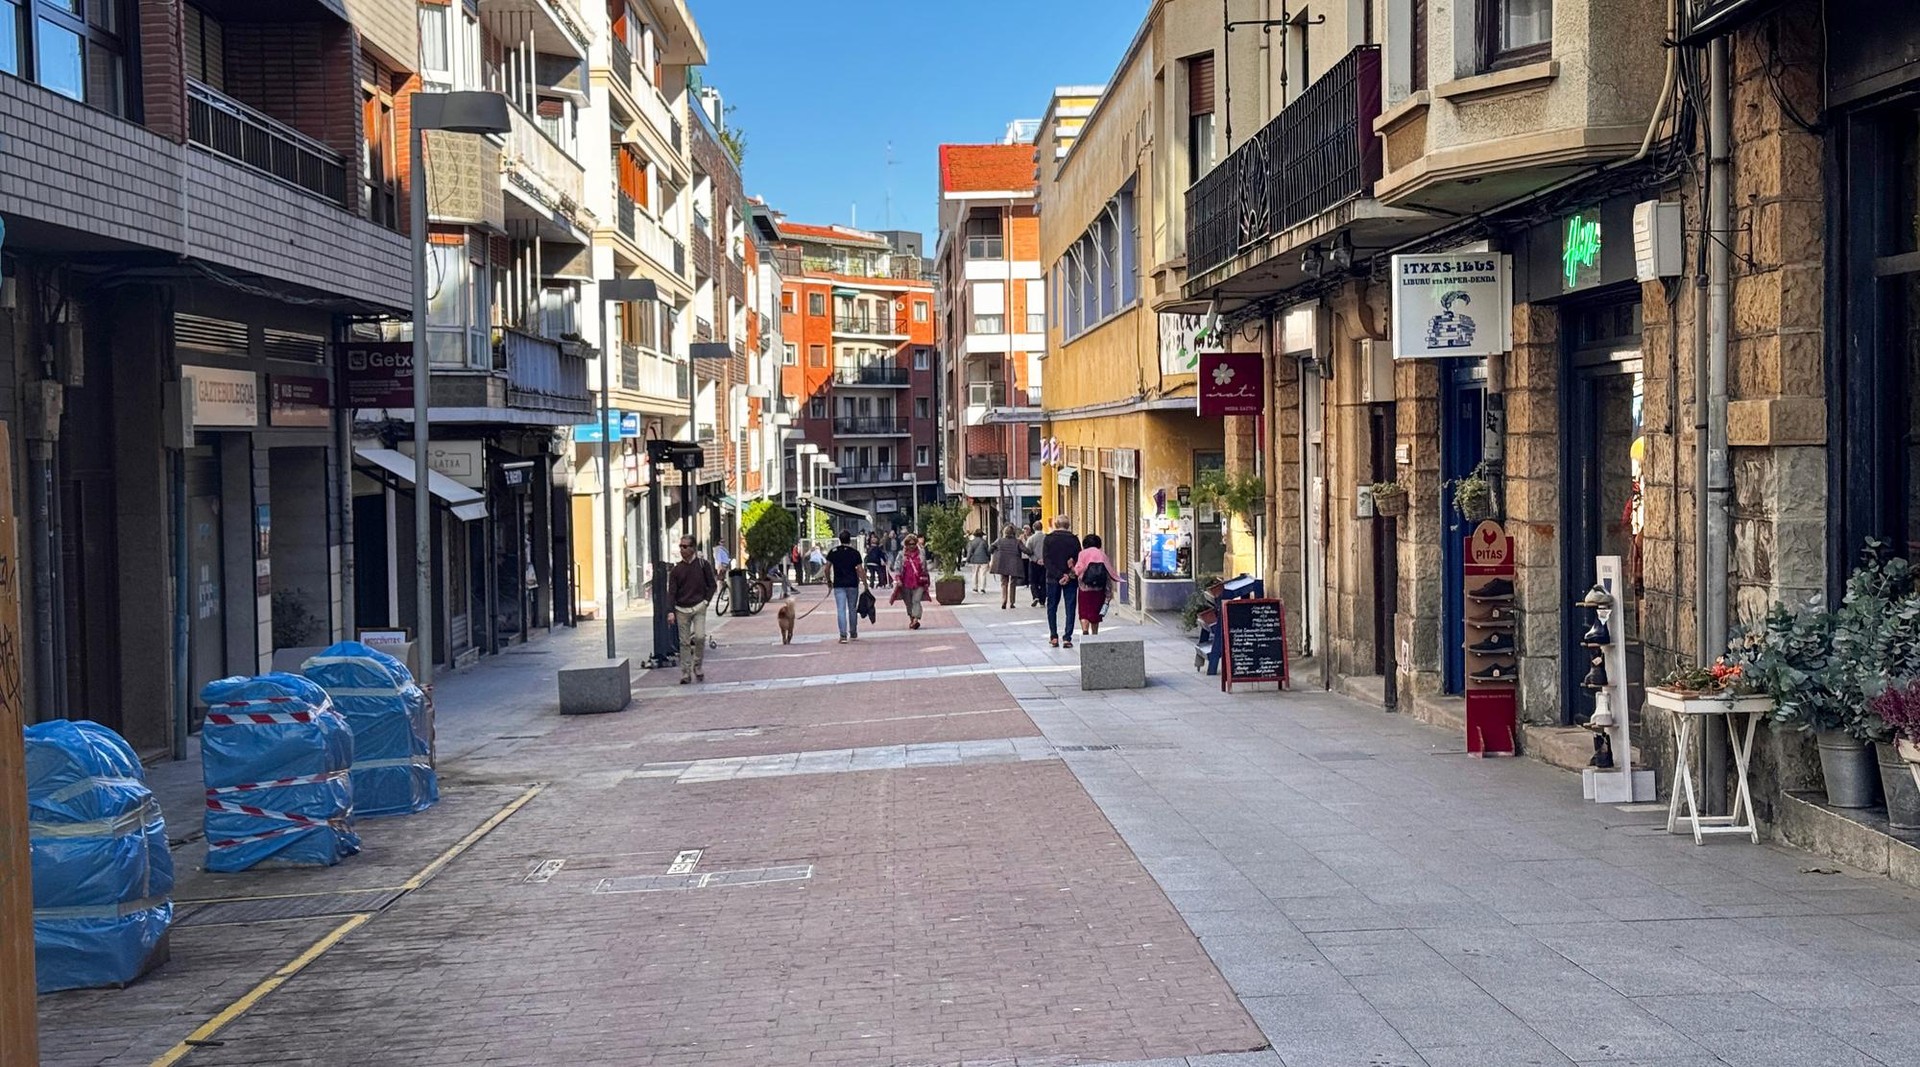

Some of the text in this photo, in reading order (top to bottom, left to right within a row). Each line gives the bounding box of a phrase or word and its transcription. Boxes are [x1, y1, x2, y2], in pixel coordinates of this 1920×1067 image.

[1444, 275, 1496, 284] PAPER-DENDA
[369, 352, 414, 367] Getx
[199, 381, 255, 404] GAZTEBULEGOA
[1476, 550, 1503, 559] PITAS
